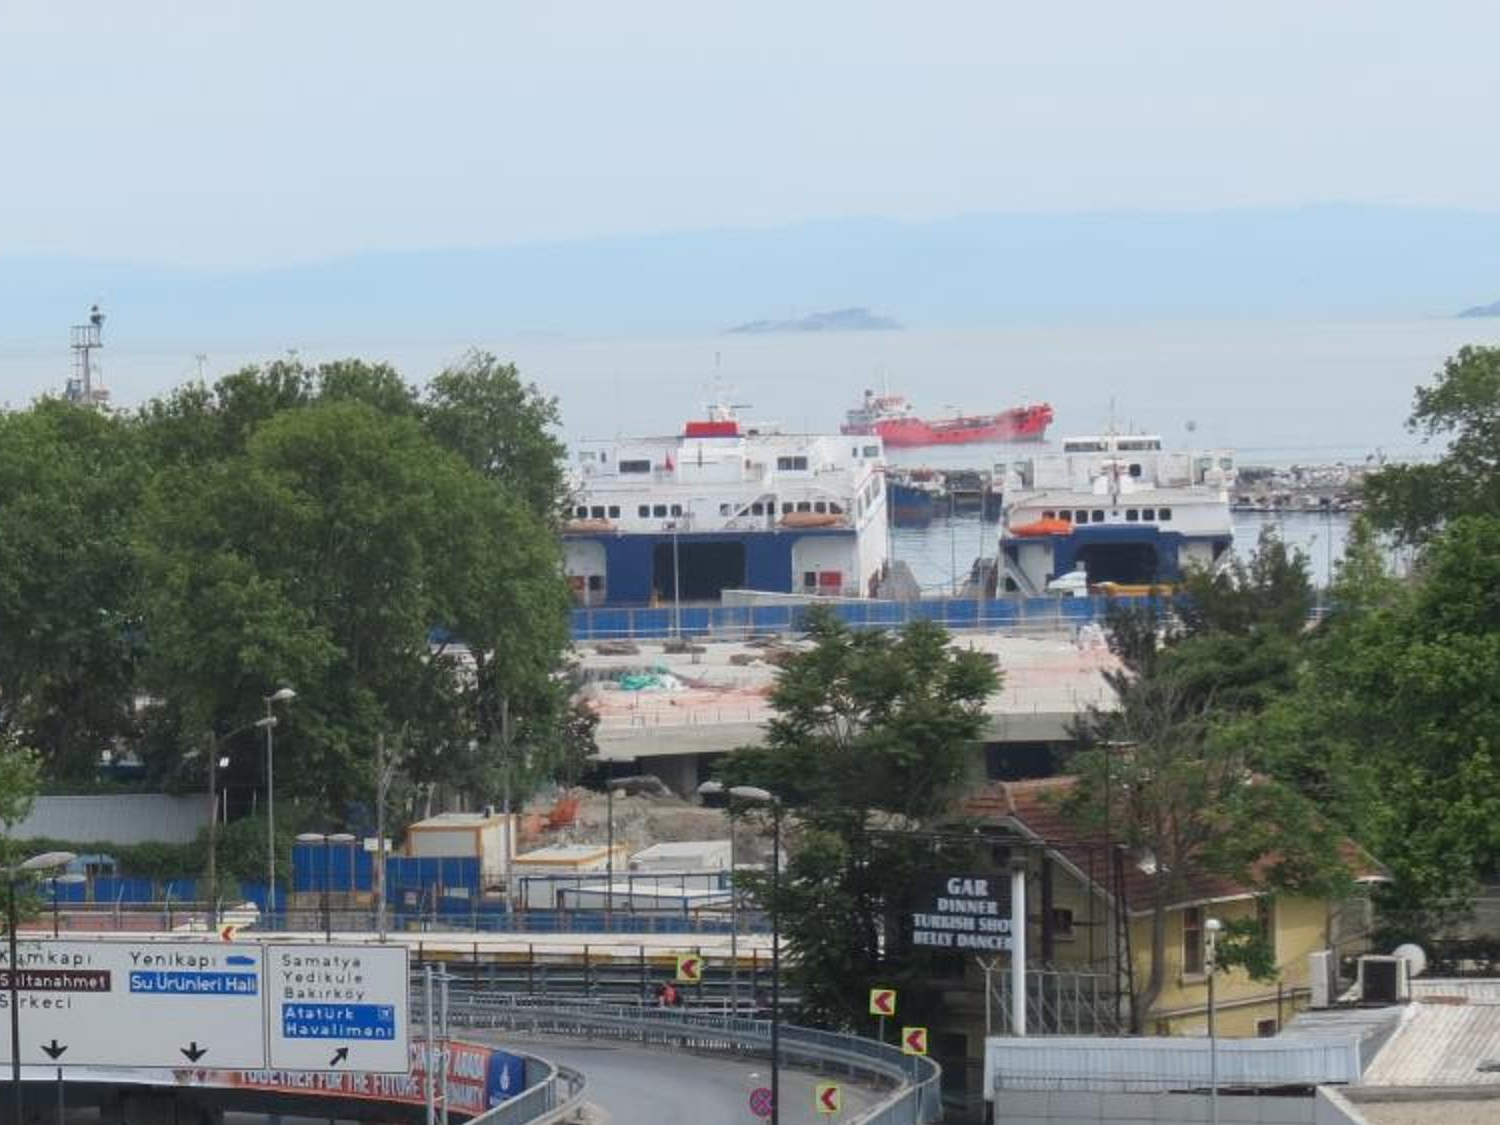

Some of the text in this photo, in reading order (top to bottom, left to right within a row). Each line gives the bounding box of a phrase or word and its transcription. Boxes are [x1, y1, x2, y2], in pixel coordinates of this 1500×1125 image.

[947, 877, 989, 896] GAR
[937, 898, 998, 914] DINNER
[913, 913, 1012, 933] TURKISH SHO
[913, 931, 954, 946] BELLY
[281, 953, 361, 970] Samatya
[0, 973, 108, 988] Sltanahmet
[131, 974, 153, 989] Su
[156, 971, 222, 991] Ürünleri
[282, 969, 363, 984] Yedikule
[285, 1006, 355, 1020] Atatürk
